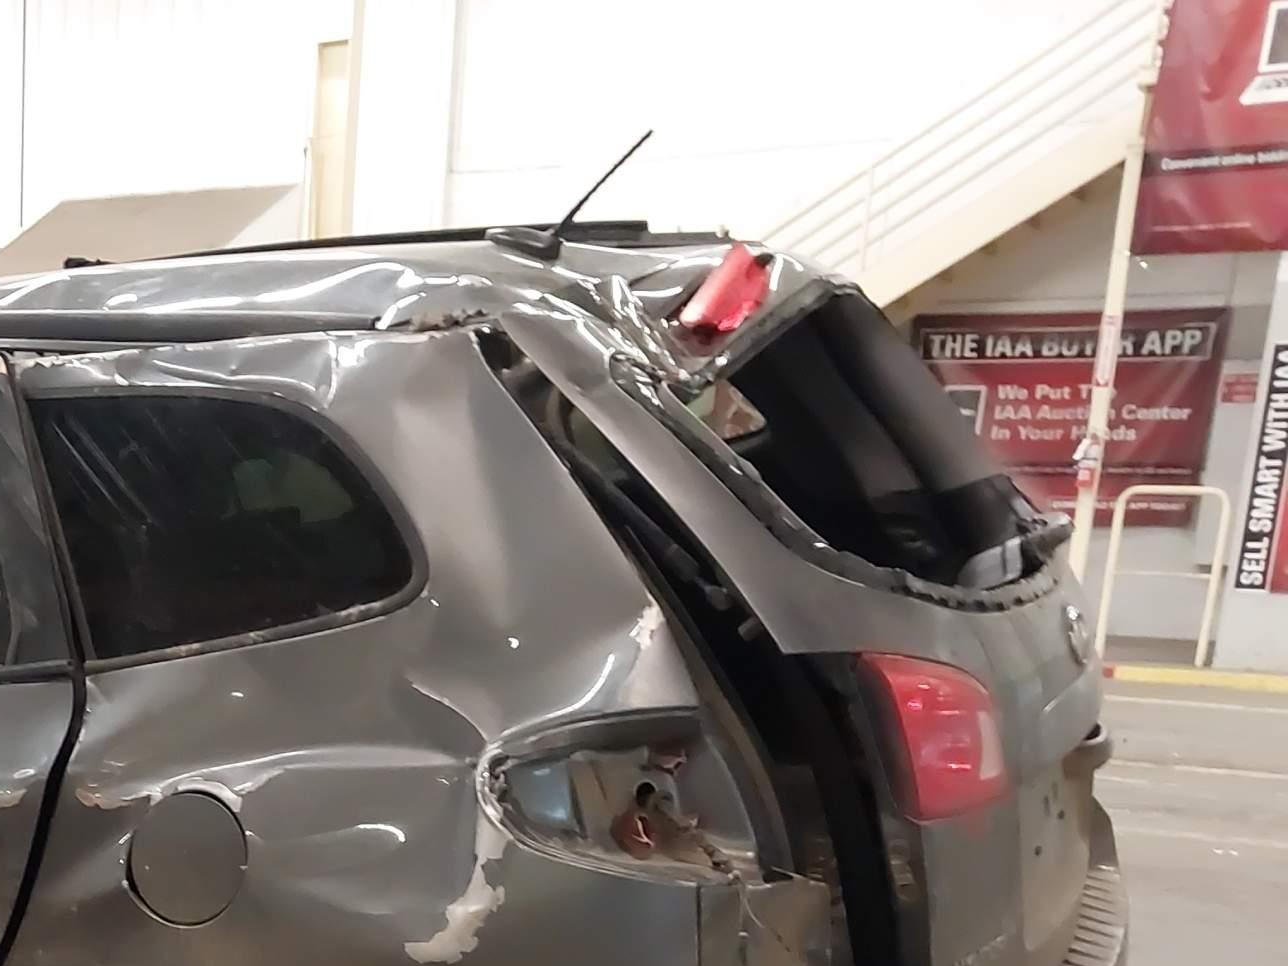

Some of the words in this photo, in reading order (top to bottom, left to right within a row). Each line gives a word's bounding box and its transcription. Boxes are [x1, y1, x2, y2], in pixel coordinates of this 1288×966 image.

[929, 334, 979, 358] THE
[984, 334, 1034, 357] IAA
[1141, 329, 1203, 355] APP
[997, 384, 1029, 400] We
[1035, 384, 1070, 400] Put
[993, 406, 1032, 420] IAA
[1122, 404, 1192, 420] Center
[1262, 391, 1288, 452] WITH
[990, 426, 1011, 440] In
[1018, 426, 1065, 440] Your
[1248, 455, 1283, 533] SMART
[1240, 536, 1270, 586] SELL
